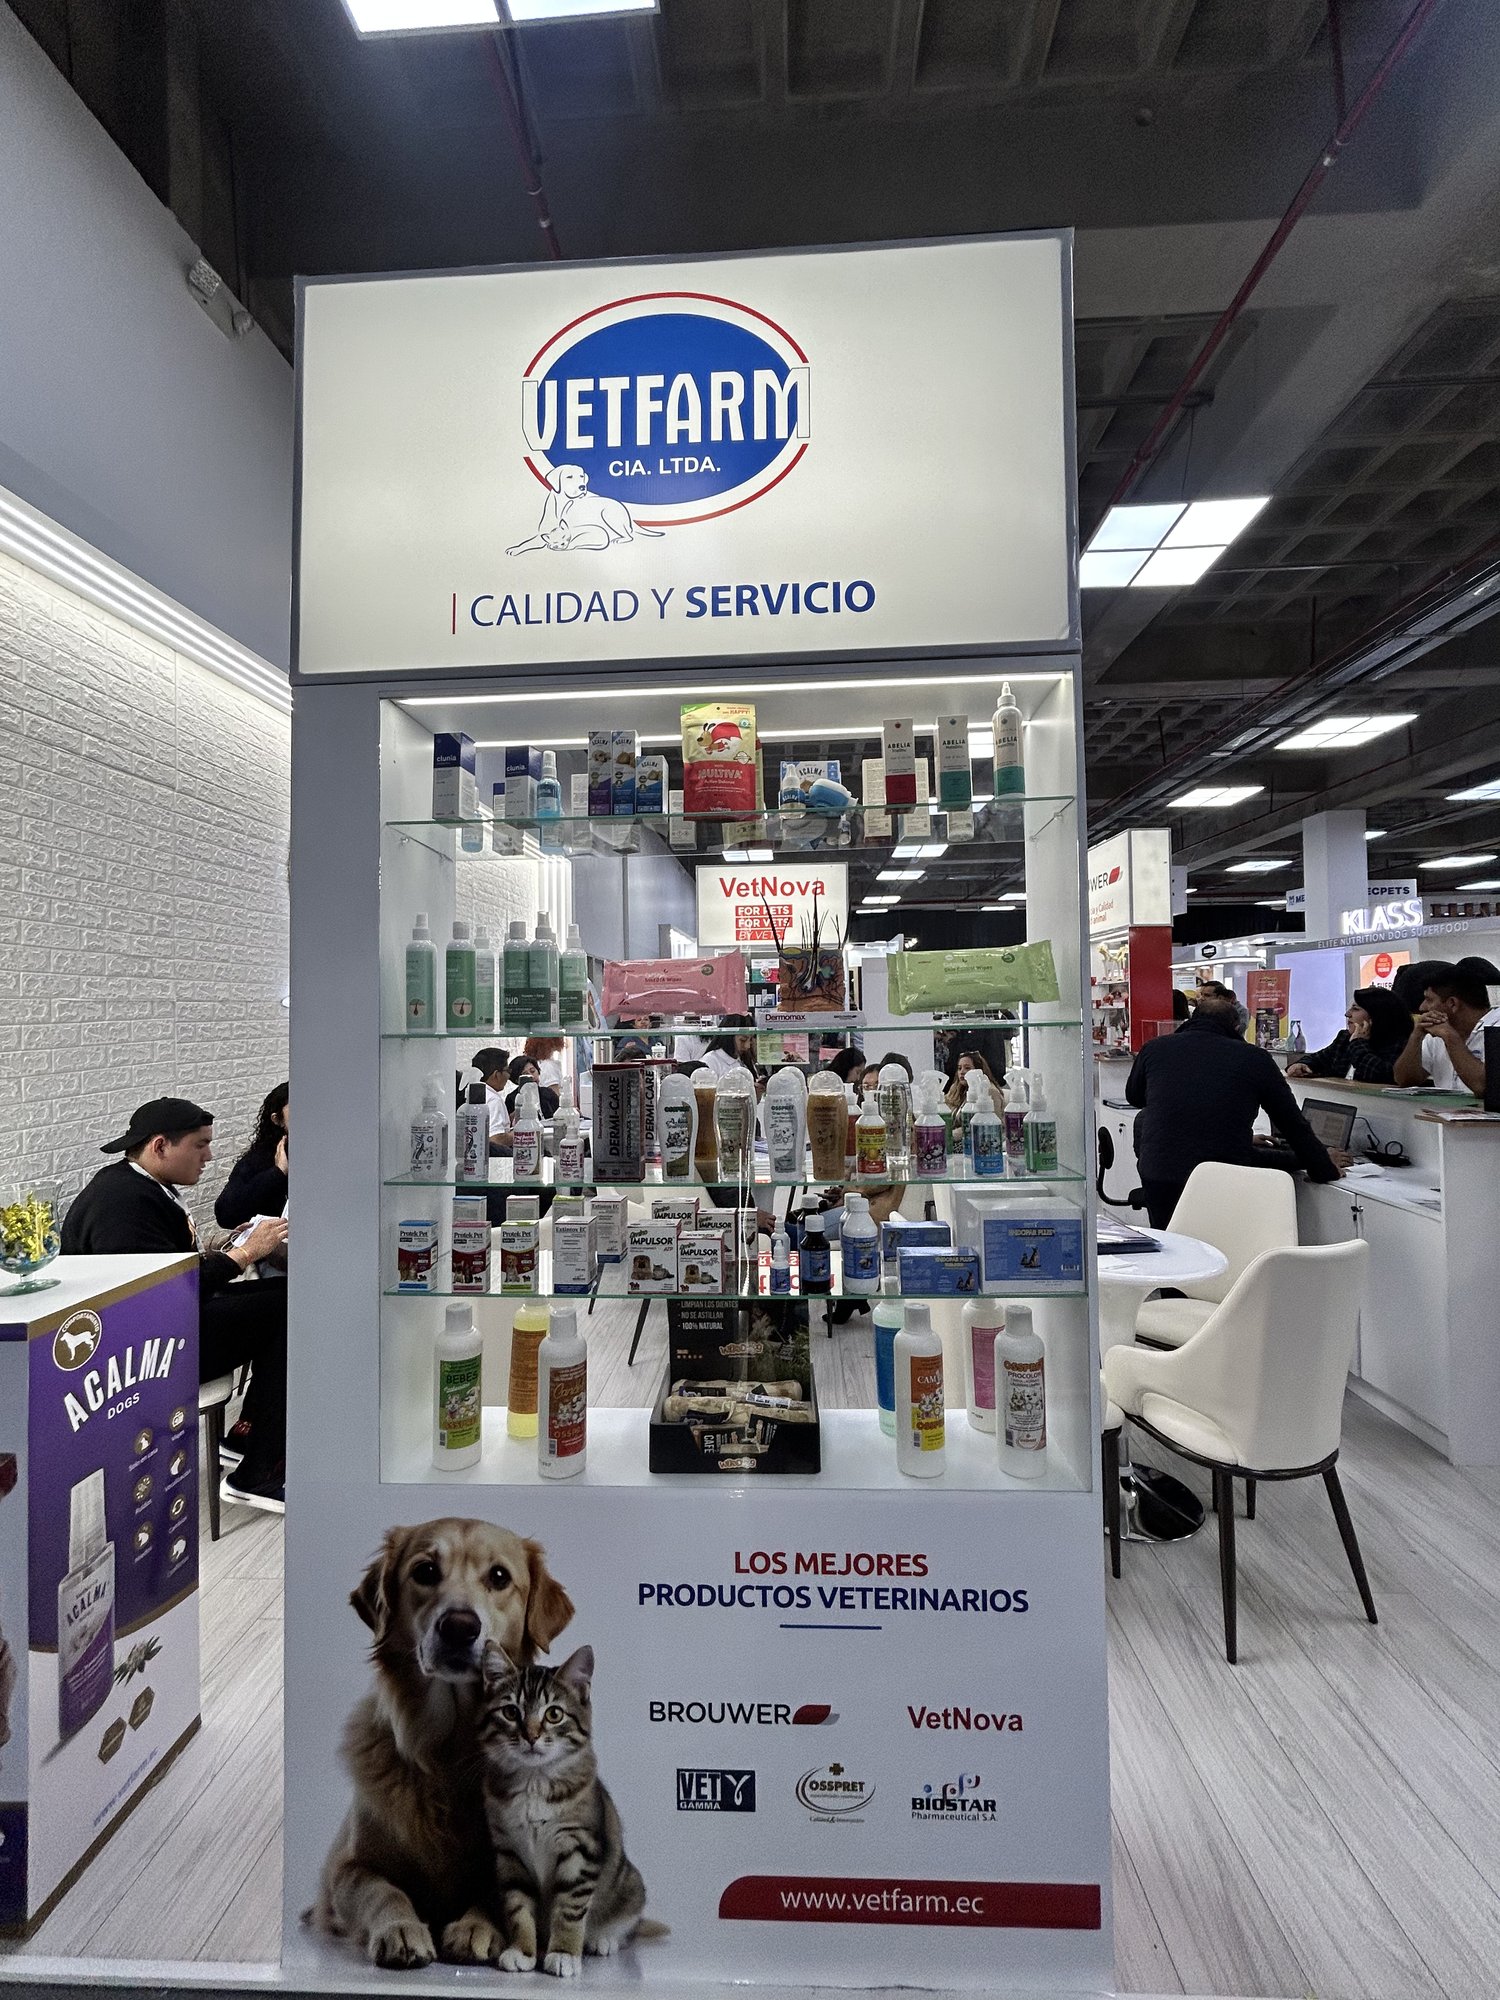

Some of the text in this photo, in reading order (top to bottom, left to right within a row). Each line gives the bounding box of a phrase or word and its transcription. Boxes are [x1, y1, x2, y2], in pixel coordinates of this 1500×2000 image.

[522, 365, 811, 452] VETFARM
[608, 456, 722, 477] CIA. LTDA.
[469, 579, 877, 628] CALIDAD Y SERVICIO
[698, 768, 741, 780] MULTIVA
[798, 767, 824, 776] ACALMA
[719, 876, 825, 898] VetNova
[738, 906, 760, 915] FOR
[1341, 899, 1424, 936] KLASS
[738, 918, 760, 927] FOR
[739, 931, 752, 940] BY
[1318, 921, 1469, 949] ELITE NUTRITION DOG SUPERFOOD
[765, 1013, 806, 1021] Dermomax
[645, 1070, 655, 1140] DERMI-CARE
[609, 1076, 620, 1157] DERMI-CARE
[654, 1211, 692, 1220] IMPULSOR
[699, 1221, 732, 1229] IMPULSOR
[630, 1237, 673, 1245] IMPULSOR
[680, 1248, 718, 1256] IMPULSOR
[681, 1300, 739, 1308] LIMPIAN LOS DIENTES
[681, 1311, 690, 1319] NO
[698, 1311, 724, 1319] ASTILLAN
[682, 1322, 723, 1330] 100% NATURAL
[446, 1371, 478, 1384] BEBES
[63, 1337, 176, 1433] ACALMA
[107, 1392, 140, 1420] DOGS
[734, 1551, 929, 1577] LOS MEJORES
[638, 1583, 1029, 1613] PRODUCTOS VETERINARIOS
[649, 1701, 791, 1725] BROUWER
[907, 1706, 1023, 1732] VetNova
[680, 1772, 721, 1802] VET
[809, 1780, 866, 1793] OSSPRET
[680, 1801, 721, 1811] GAMMA
[911, 1797, 997, 1812] BIOSTAR
[911, 1811, 979, 1821] Pharmaceutical
[781, 1888, 984, 1916] www.vetfarm.ec
